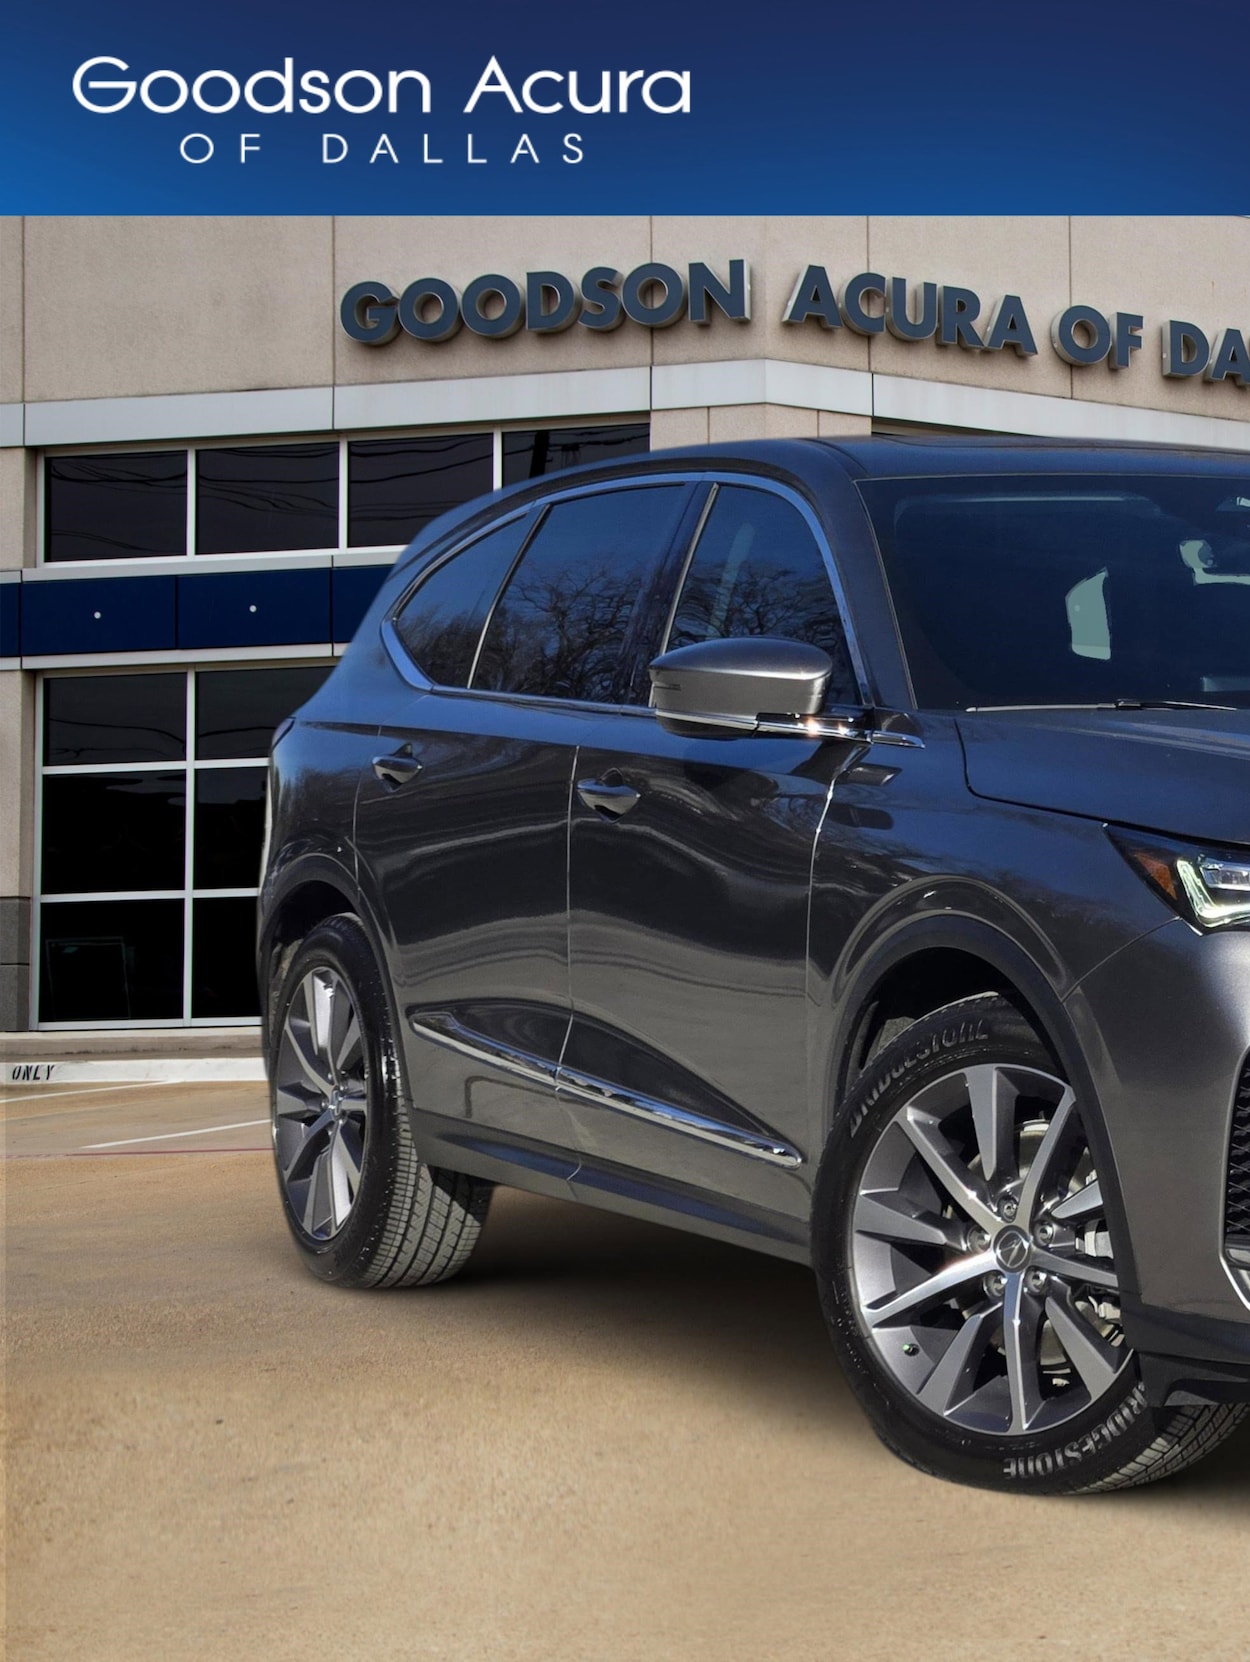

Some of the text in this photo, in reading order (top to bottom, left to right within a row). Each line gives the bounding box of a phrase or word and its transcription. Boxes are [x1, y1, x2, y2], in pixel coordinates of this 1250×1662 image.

[340, 258, 752, 346] GOODSON
[782, 264, 1039, 357] ACURA
[1051, 304, 1144, 368] OF
[12, 1064, 55, 1081] ONLY
[1003, 1381, 1148, 1480] RIDGESTONE
